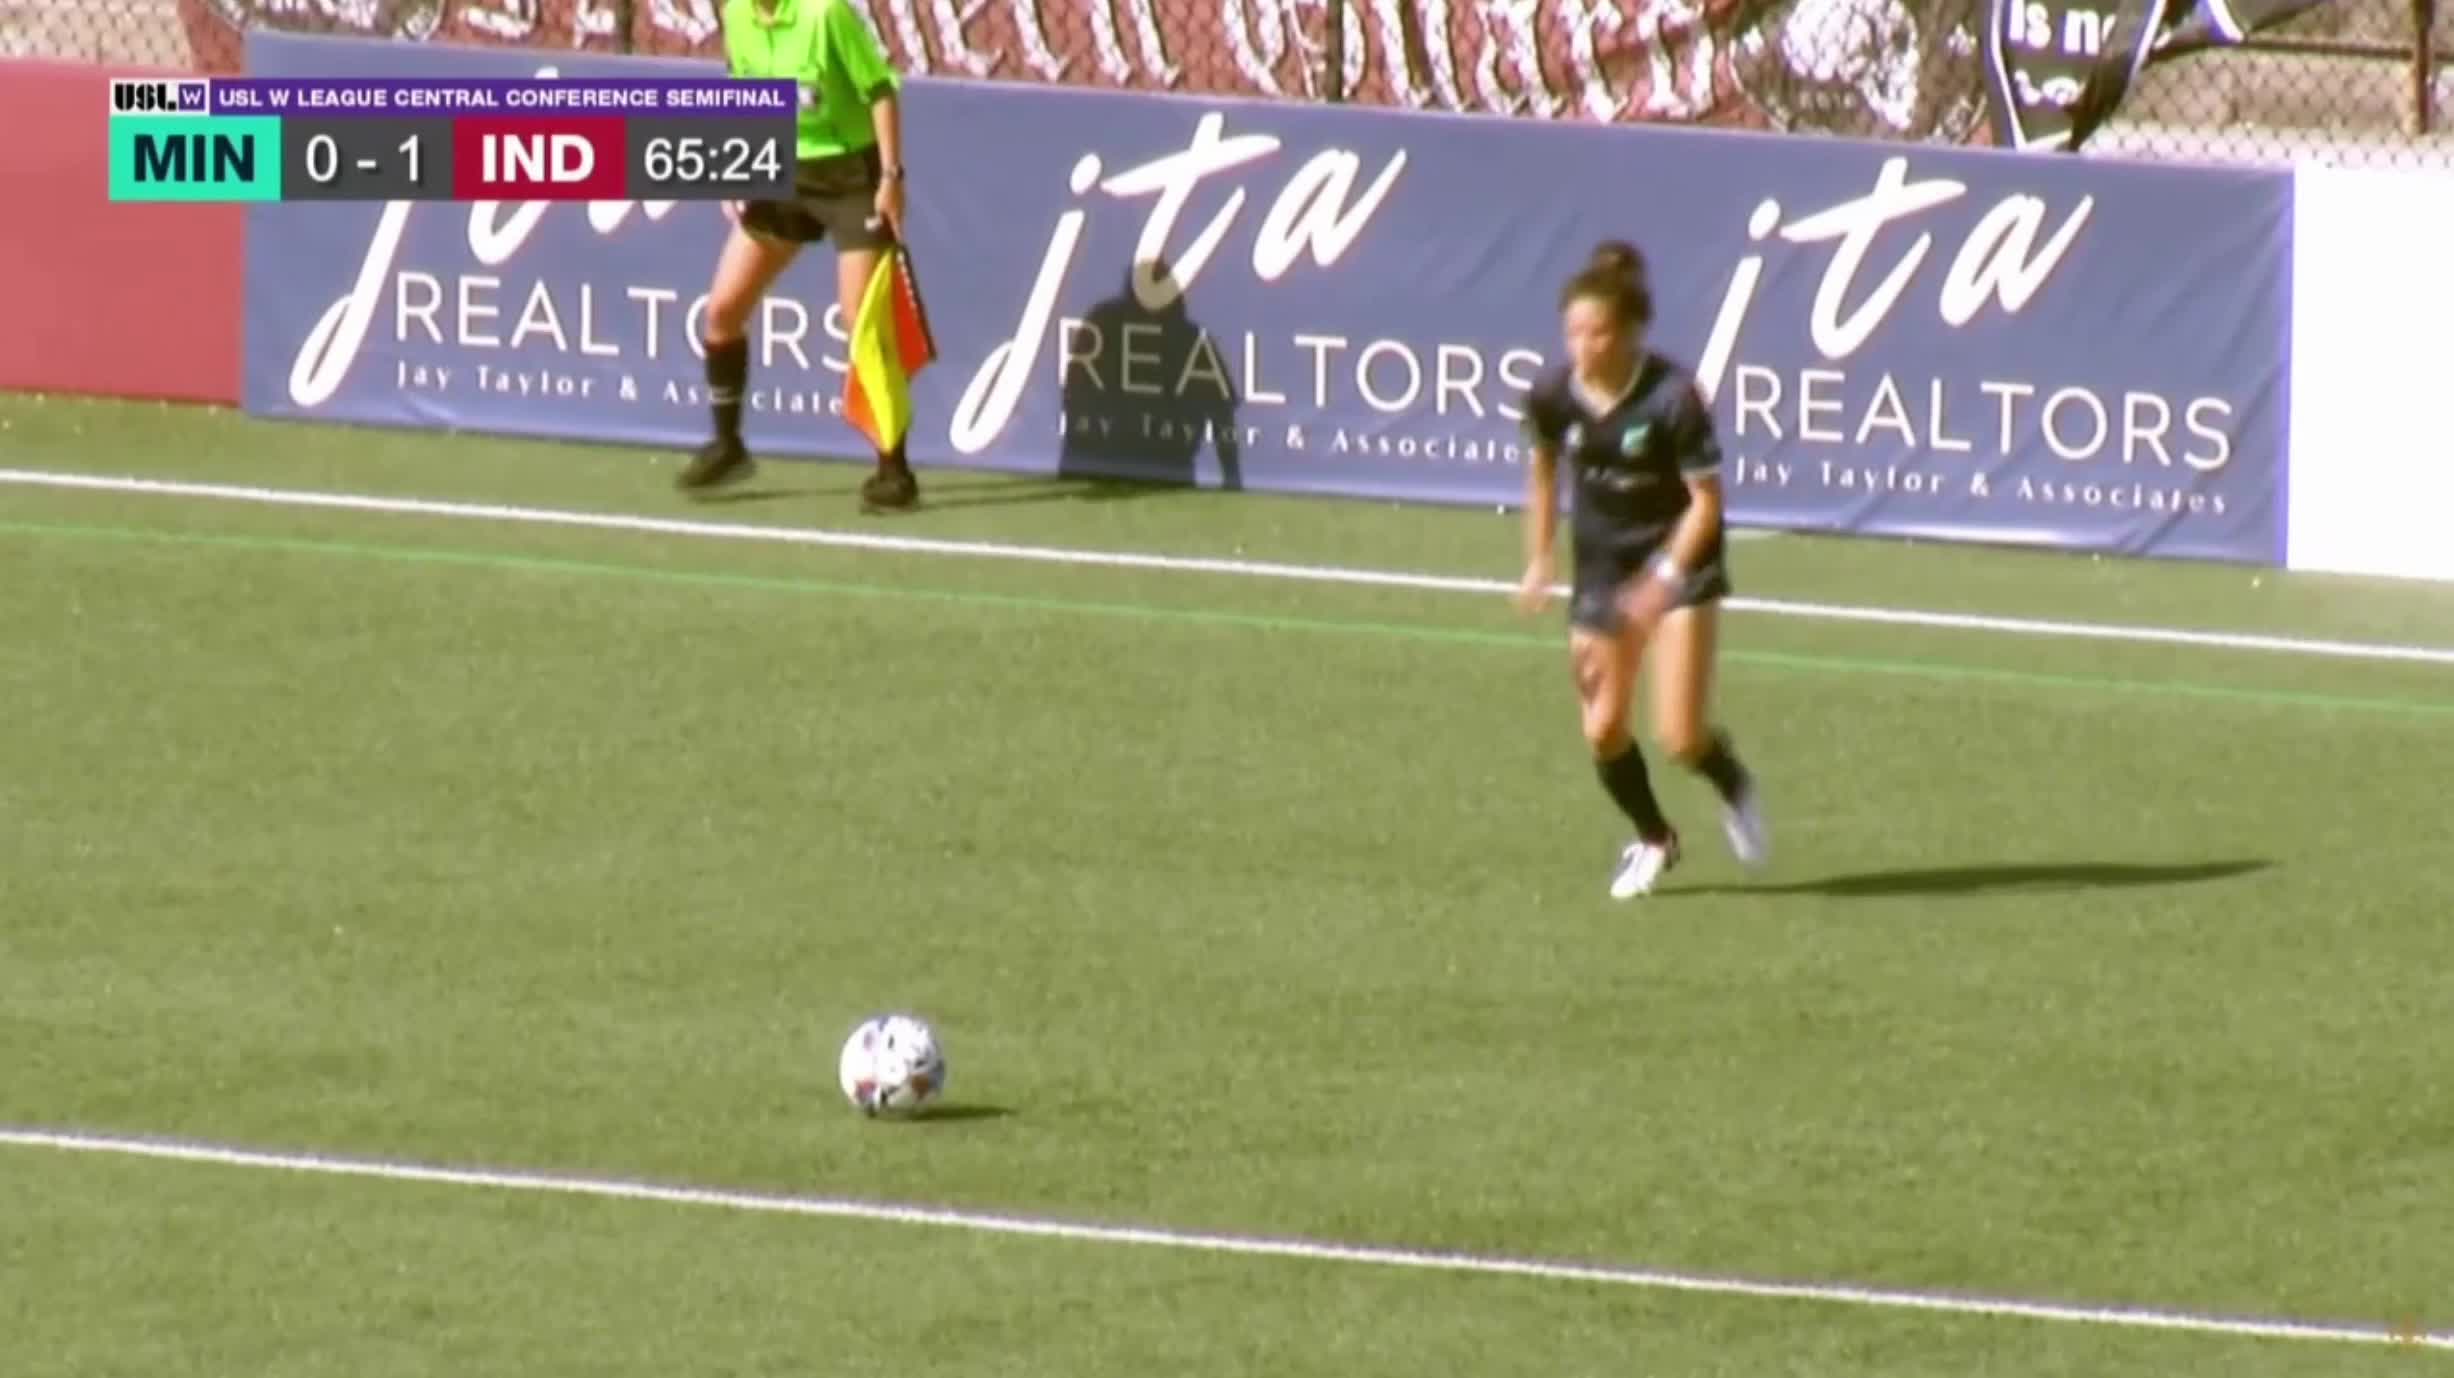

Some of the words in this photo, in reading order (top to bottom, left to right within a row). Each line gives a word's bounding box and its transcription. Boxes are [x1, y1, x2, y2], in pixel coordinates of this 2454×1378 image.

[949, 112, 1407, 454] jta
[398, 361, 448, 391] Jay
[478, 364, 594, 398] Taylor
[619, 374, 638, 401] &
[1059, 317, 1545, 421] REALTORS
[1142, 413, 1262, 447] Taylor
[1286, 423, 1306, 450] &
[1735, 364, 2232, 470] REALTORS
[1735, 455, 1793, 487] Jay
[1820, 458, 1945, 495] Taylor
[1969, 471, 1989, 498] &
[2017, 475, 2226, 516] Associates
